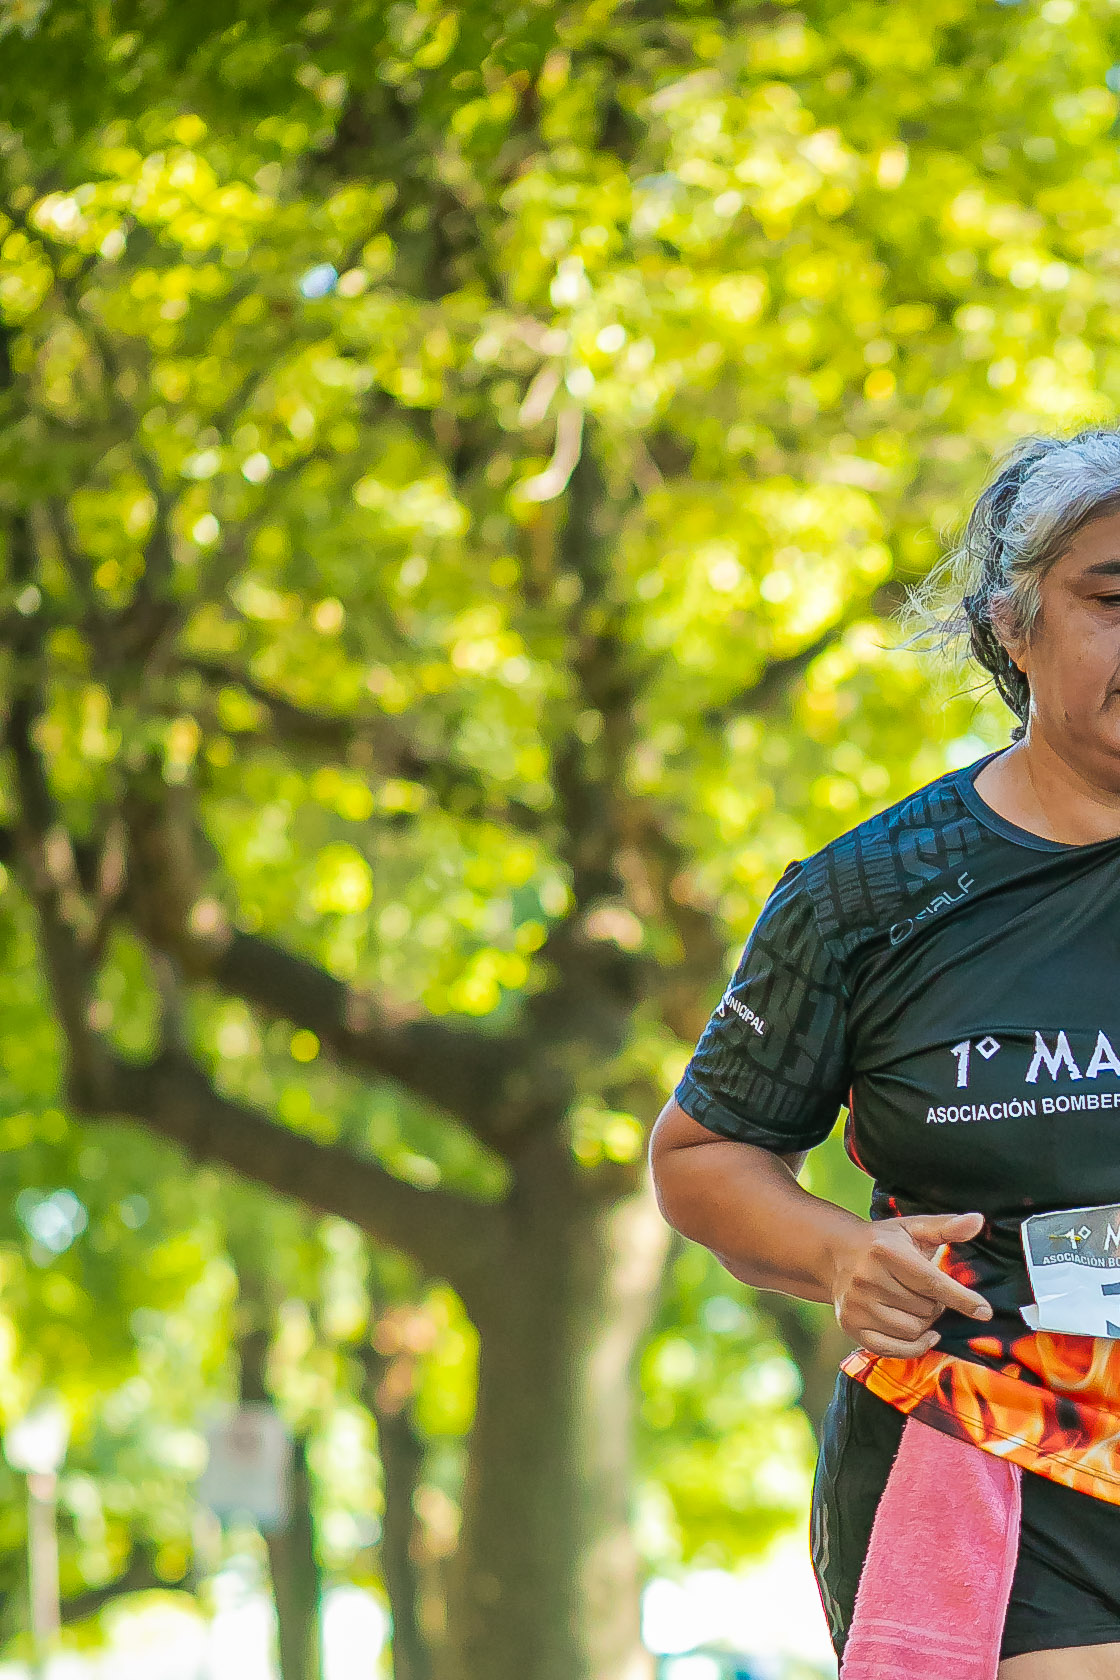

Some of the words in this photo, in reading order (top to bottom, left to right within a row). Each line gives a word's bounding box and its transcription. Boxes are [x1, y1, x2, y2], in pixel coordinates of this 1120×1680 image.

[723, 994, 765, 1035] UNICIPAL
[925, 1098, 1037, 1124] ASOCIACIÓN
[1042, 1251, 1105, 1268] ASOCIACIÓN
